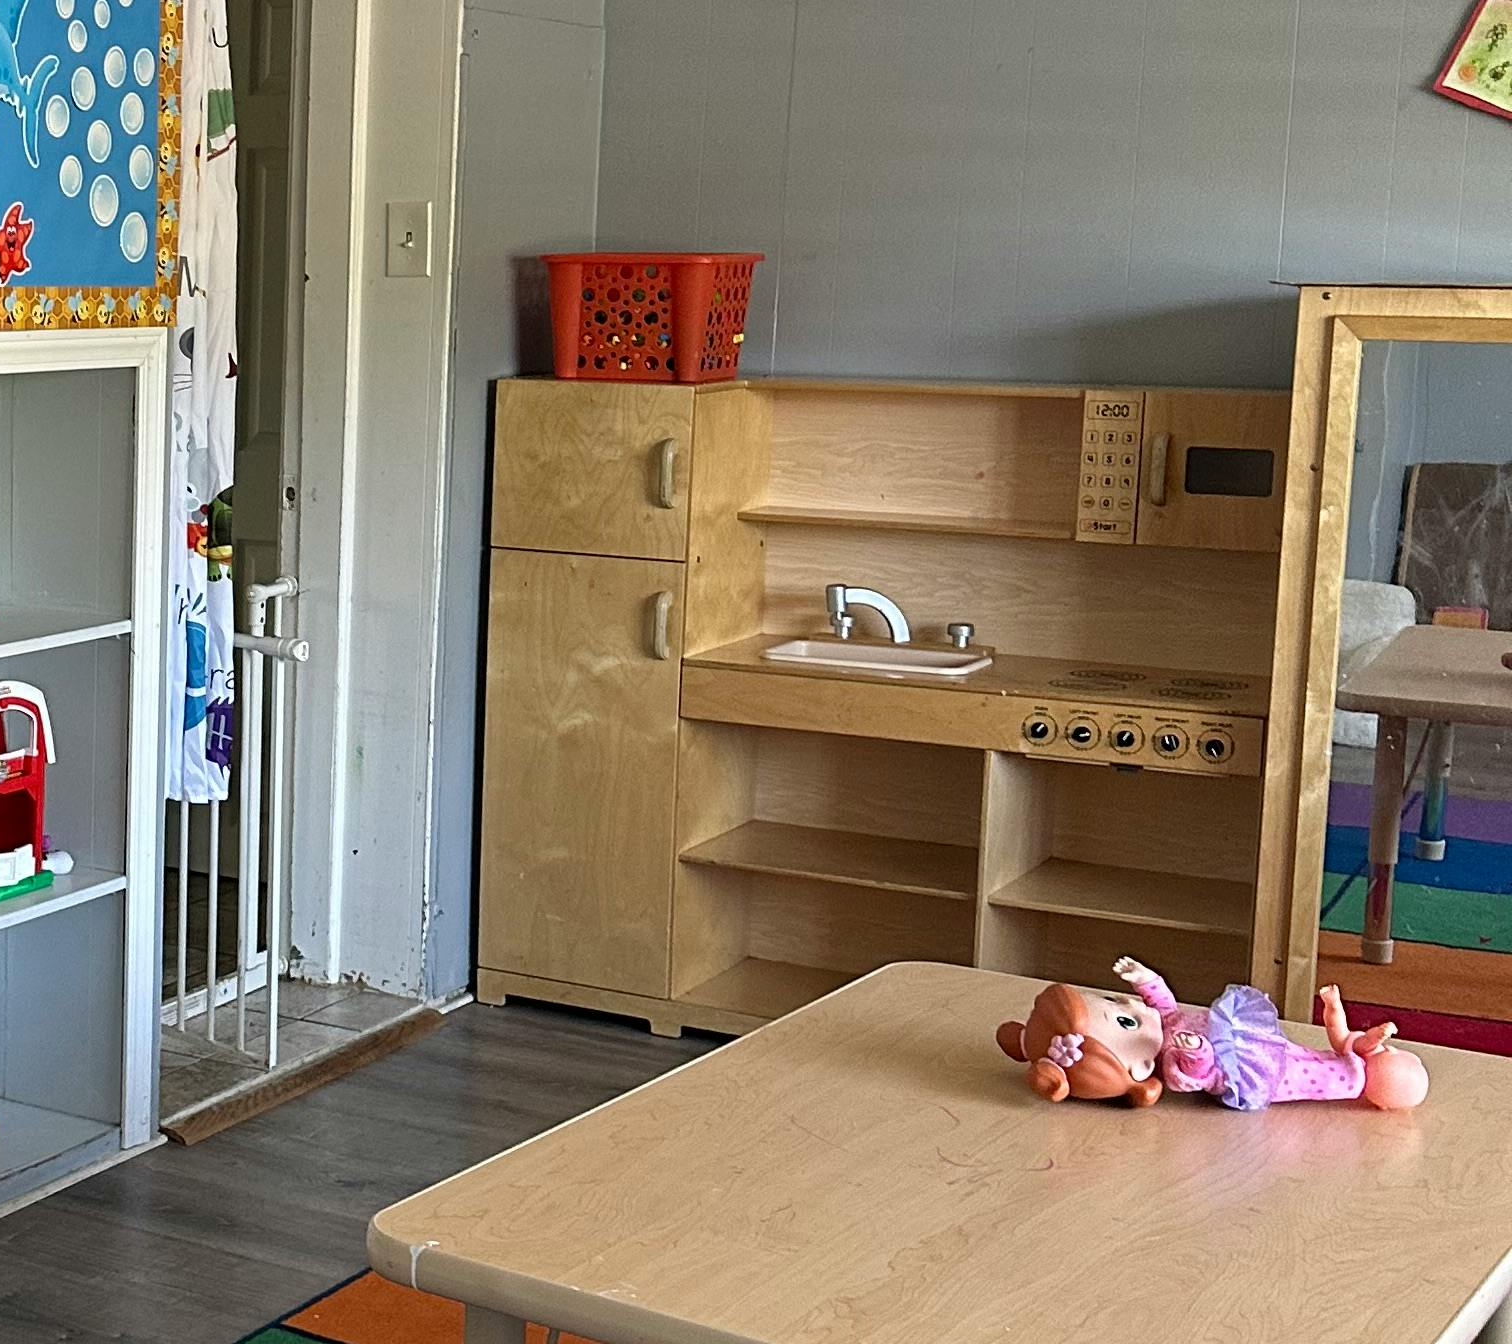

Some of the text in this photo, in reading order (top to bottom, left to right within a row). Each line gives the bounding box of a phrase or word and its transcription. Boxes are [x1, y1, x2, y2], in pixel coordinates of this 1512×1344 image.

[1096, 404, 1130, 418] 12:00
[1108, 434, 1114, 442] 2
[1127, 435, 1133, 443] 3
[1125, 456, 1131, 464] 6
[1086, 476, 1130, 486] 7 8 9
[1093, 522, 1117, 531] Start
